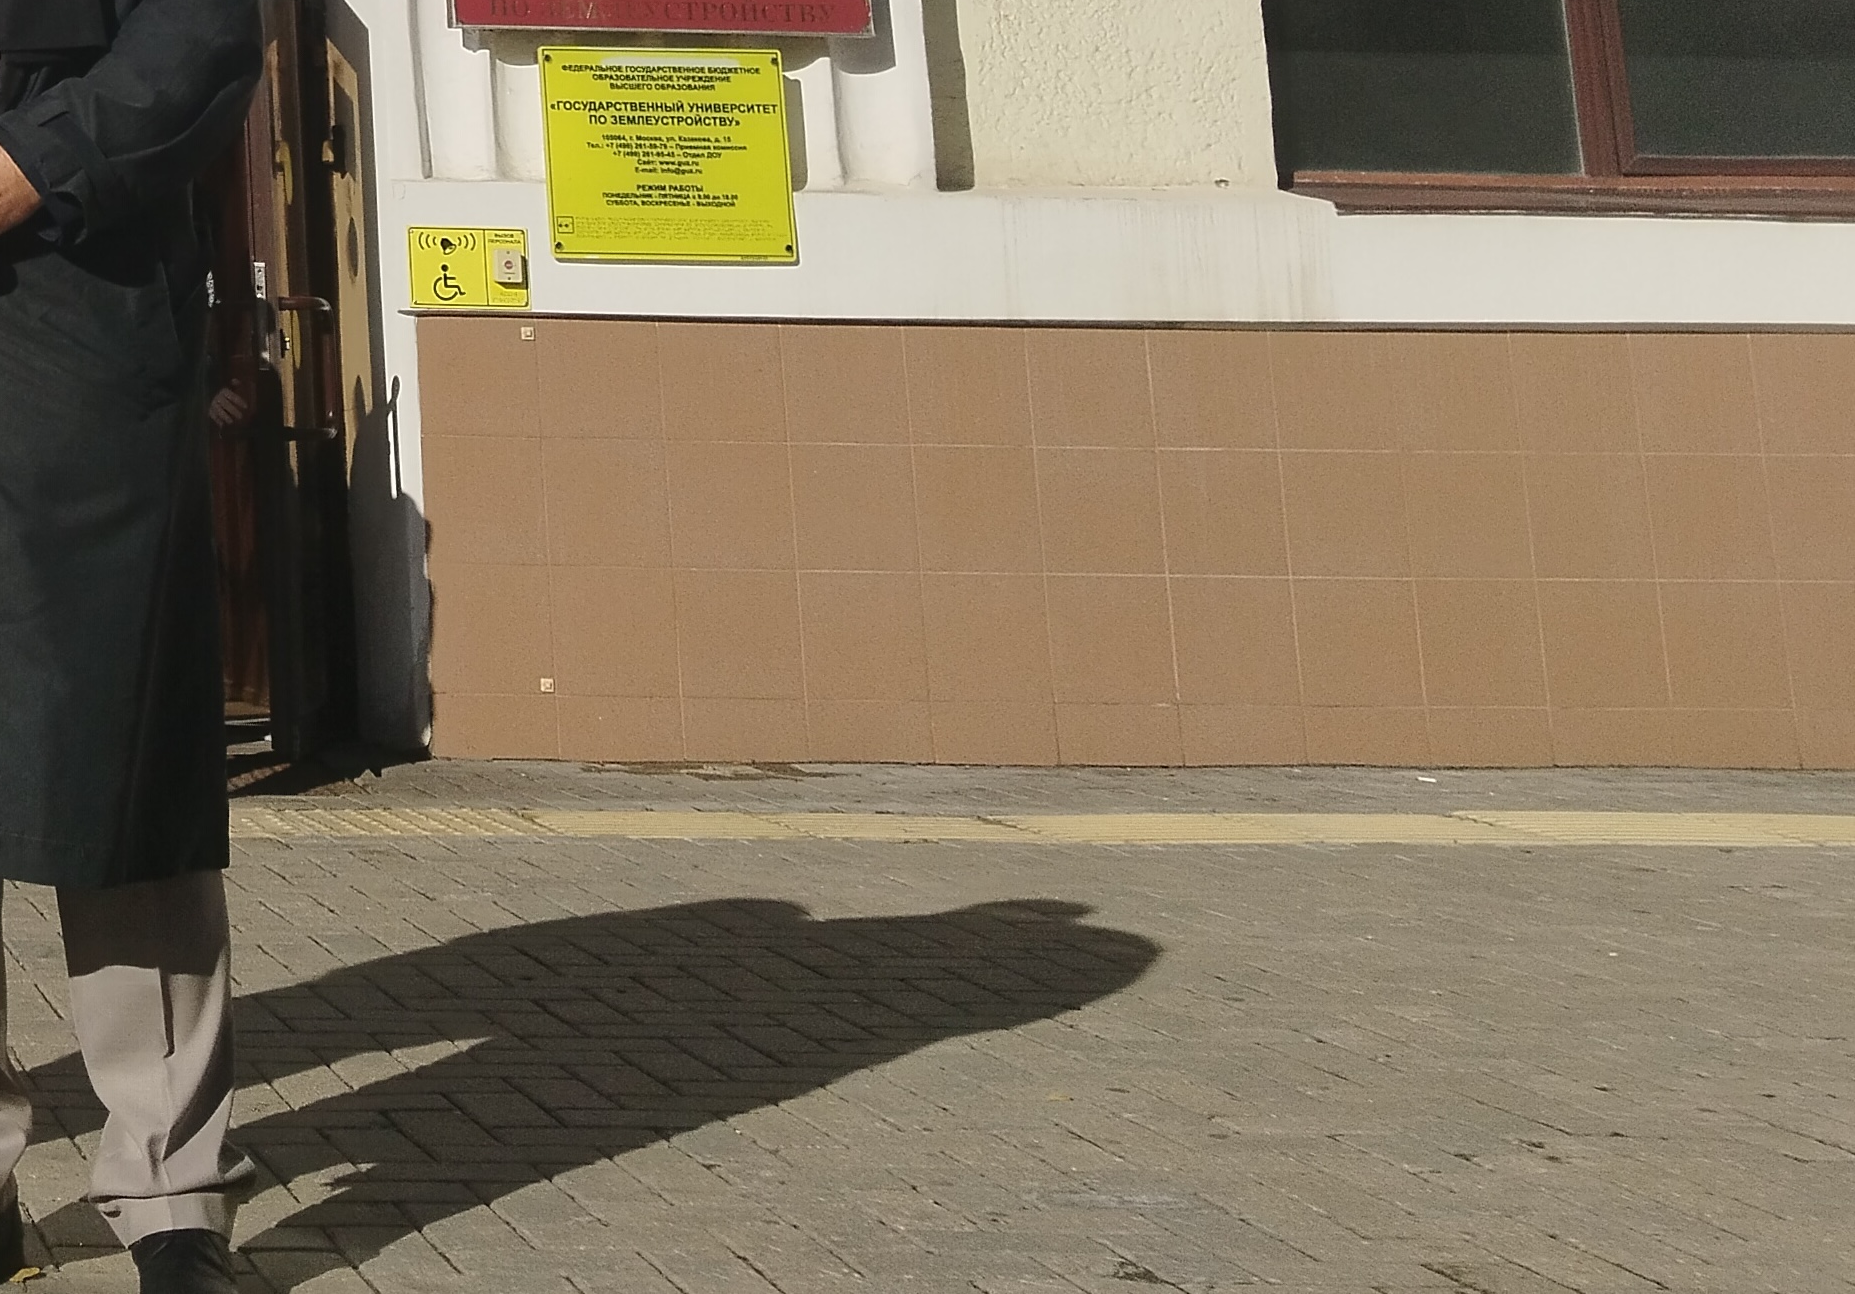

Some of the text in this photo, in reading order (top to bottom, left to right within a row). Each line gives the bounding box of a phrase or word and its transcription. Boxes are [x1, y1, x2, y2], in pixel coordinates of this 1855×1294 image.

[561, 64, 760, 75] ФЕДЕРАЛЬНОЕ ГОСУДАРСТВЕННОЕ БЮДЖЕТНОЕ
[592, 73, 731, 83] ОБРАЗОВАТЕЛЬНОЕ УЧРЕЖДЕНИЕ
[609, 82, 715, 91] ВЫСШЕГО ОБРАЗОВАНИЯ
[550, 100, 778, 114] «ГОСУДАРСТВЕННЫЙ УНИВЕРСИТЕТ
[589, 113, 741, 126] ПО ЗЕМЛЕУСТРОЙСТВУ»
